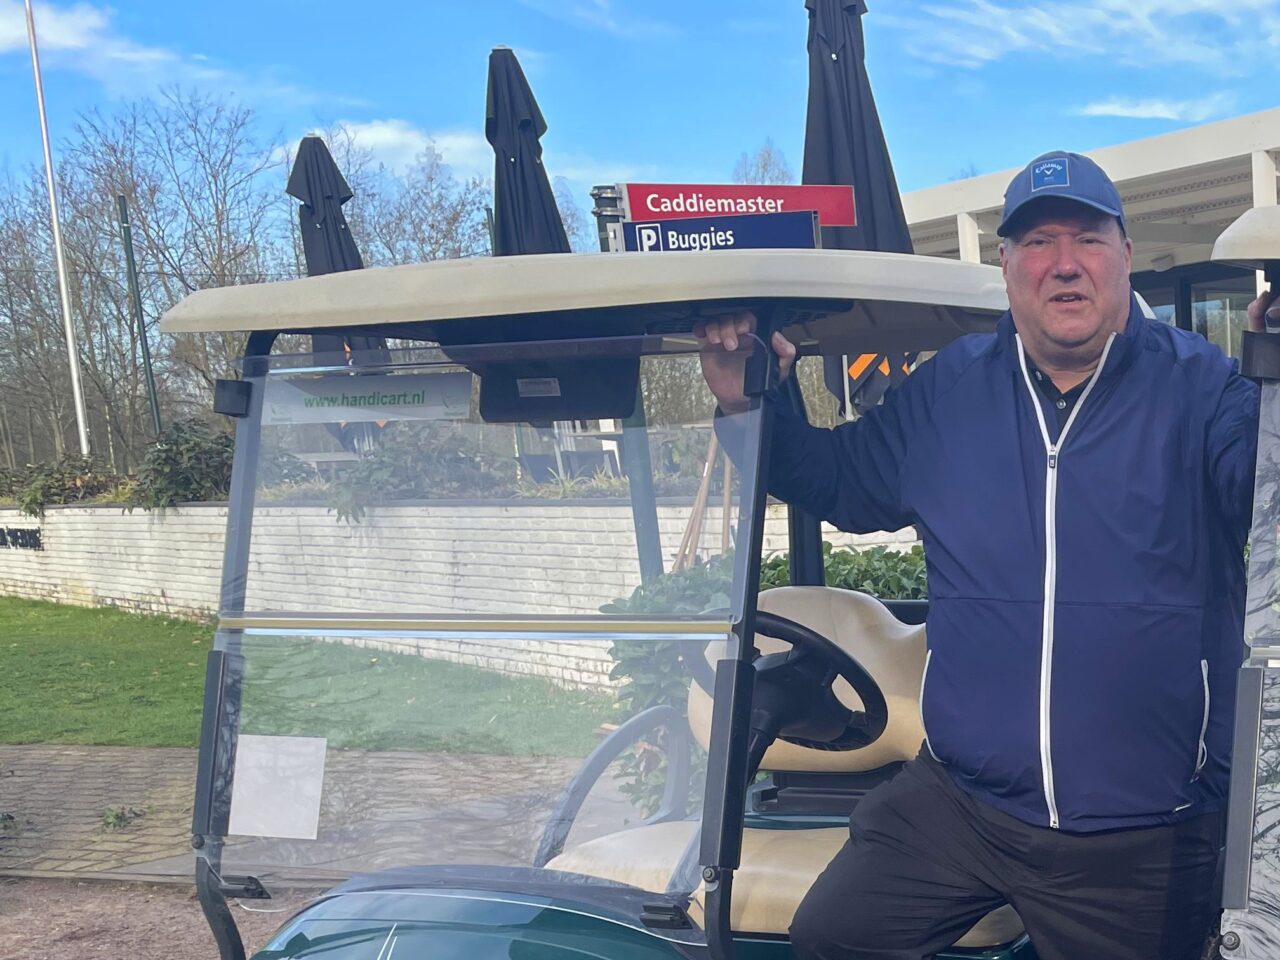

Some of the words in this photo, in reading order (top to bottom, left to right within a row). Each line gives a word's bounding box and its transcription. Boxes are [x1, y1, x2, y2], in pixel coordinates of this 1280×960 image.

[645, 193, 784, 213] Caddiemaster
[641, 229, 657, 251] P
[668, 228, 735, 251] Buggies
[304, 390, 426, 409] www.handicart.nl
